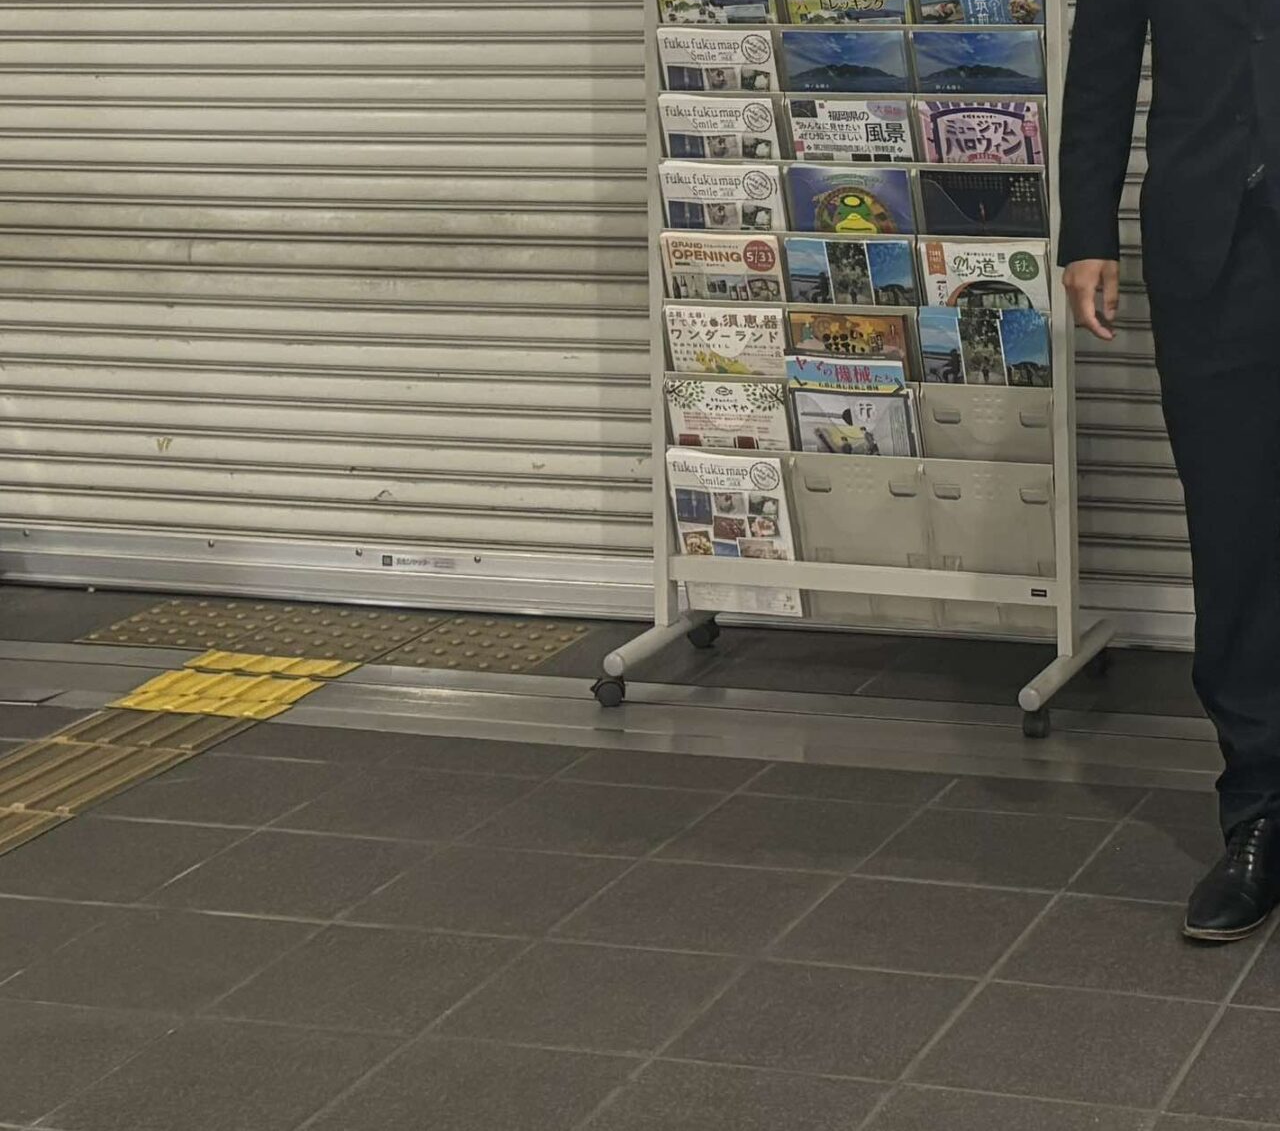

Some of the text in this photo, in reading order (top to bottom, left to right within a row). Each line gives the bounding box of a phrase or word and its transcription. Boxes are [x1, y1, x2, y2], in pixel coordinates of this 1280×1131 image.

[717, 40, 740, 54] map
[691, 51, 717, 62] Smile
[719, 109, 742, 122] map
[828, 110, 870, 122] 福岡県の
[692, 118, 718, 130] Smile
[946, 120, 1017, 136] ミュージアム
[865, 122, 907, 144] 風景
[945, 134, 1022, 158] ハロウィン
[719, 176, 741, 189] map
[692, 186, 719, 197] Smile
[671, 241, 703, 249] GRAND
[672, 249, 742, 263] OPENING
[671, 328, 779, 343] ワンダーランド
[726, 466, 749, 480] map
[699, 474, 725, 486] Smile
